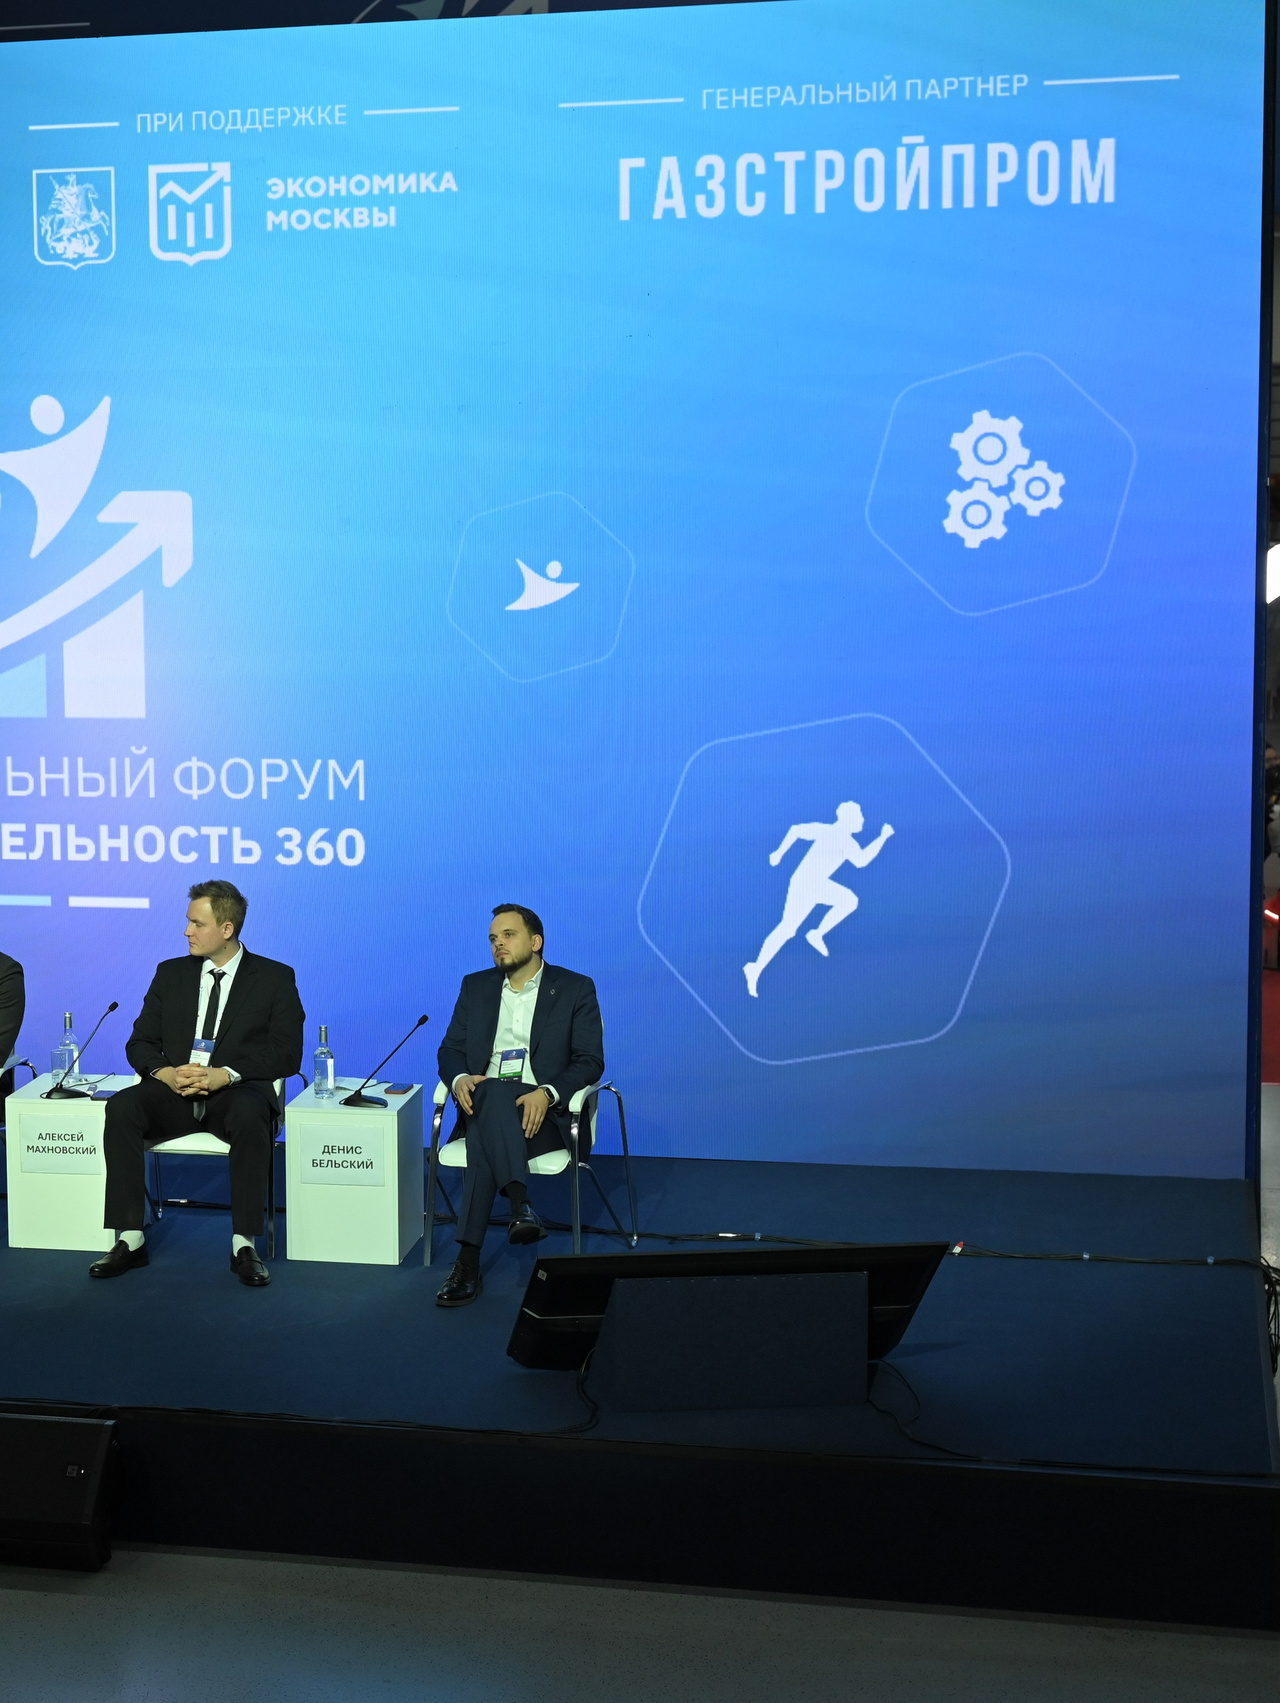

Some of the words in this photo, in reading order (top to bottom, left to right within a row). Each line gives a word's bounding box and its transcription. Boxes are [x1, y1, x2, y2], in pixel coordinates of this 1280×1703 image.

[702, 75, 898, 110] ГЕНЕРАЛЬНЫЙ
[905, 74, 1029, 100] ПАРТНЕР
[136, 112, 184, 133] ПРИ
[192, 104, 348, 134] ПОДДЕРЖКЕ
[266, 171, 459, 200] ЭКОНОМИКА
[618, 135, 1117, 221] ГАЗСТРОЙПРОМ
[266, 206, 396, 231] МОСКВЫ
[173, 756, 366, 801] ФОРУМ
[275, 827, 366, 867] 360
[26, 1143, 97, 1155] МАХНОВСКИЙ
[37, 1130, 84, 1143] АЛЕКСЕЙ
[321, 1144, 363, 1157] ДЕНИС
[311, 1156, 374, 1170] БЕЛЬСКИЙ
